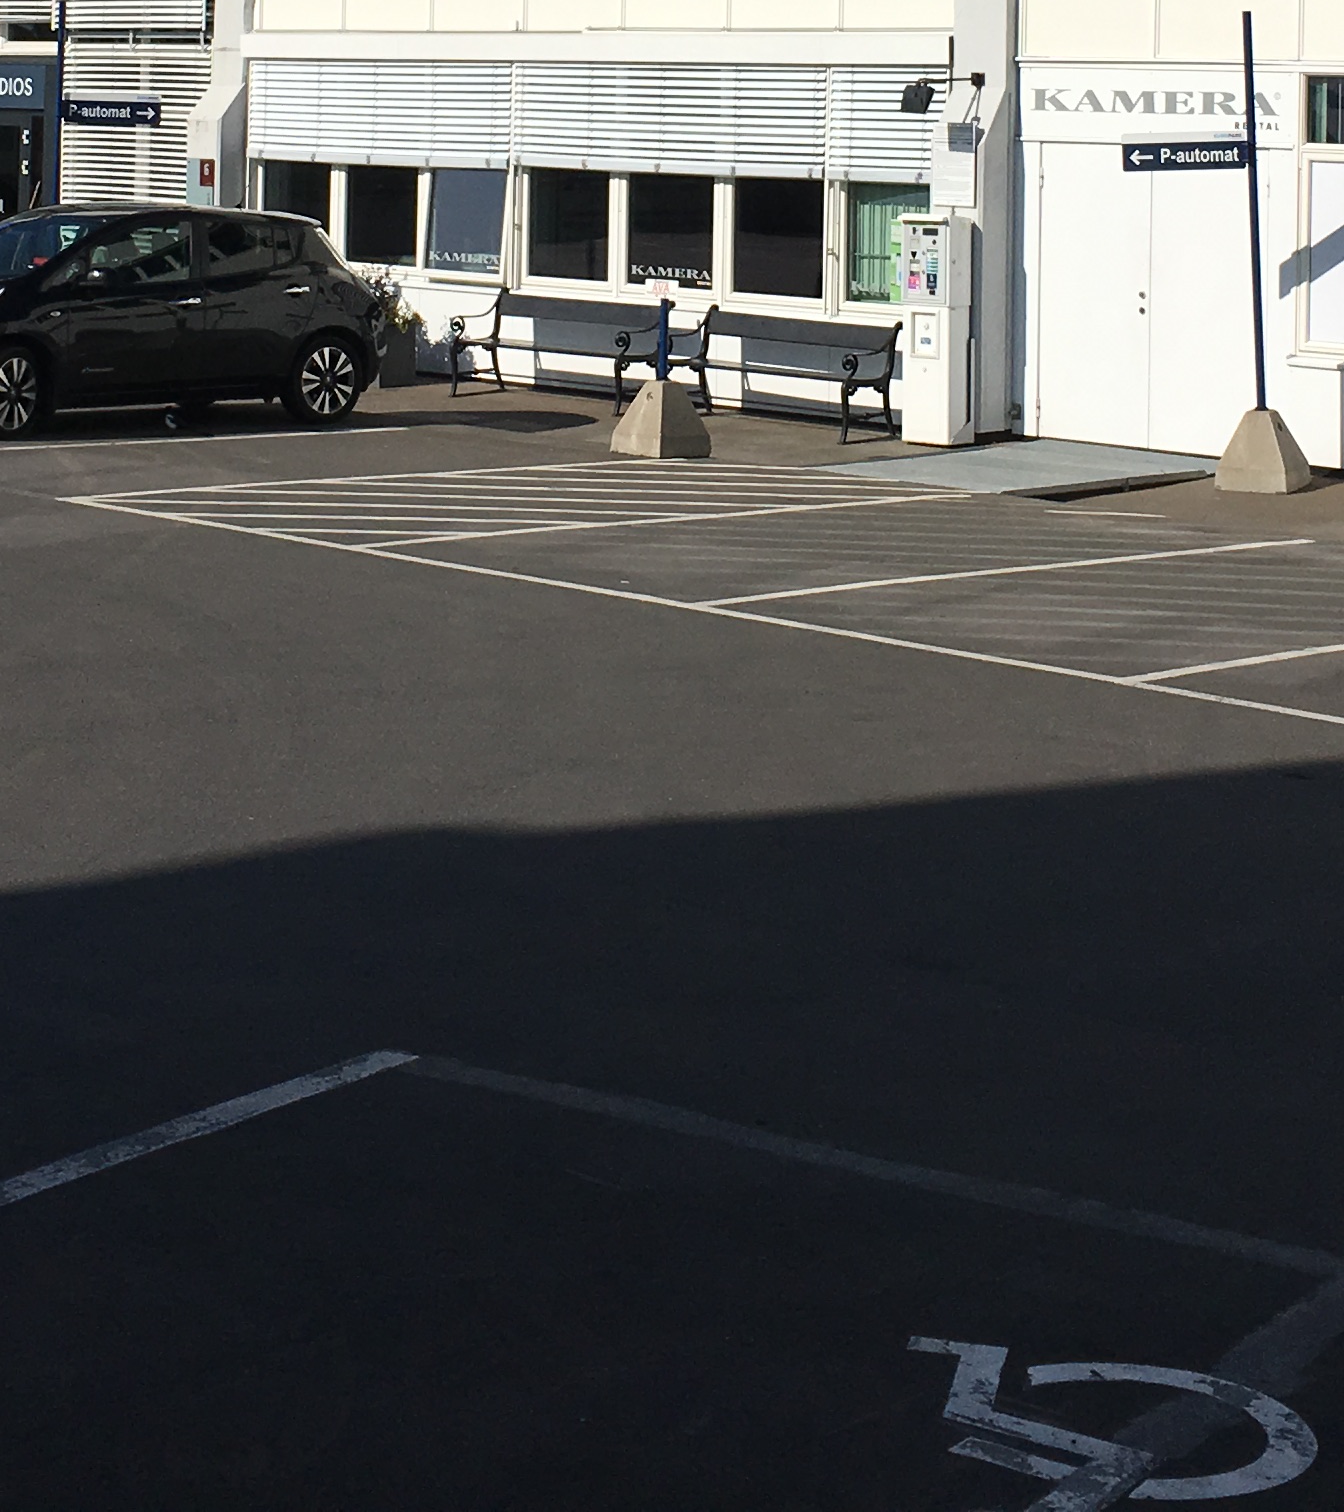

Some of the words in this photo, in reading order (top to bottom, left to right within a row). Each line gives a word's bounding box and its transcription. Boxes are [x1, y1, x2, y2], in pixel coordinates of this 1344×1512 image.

[1030, 88, 1280, 117] KAMERA
[69, 104, 131, 118] P-automat
[1234, 121, 1280, 131] RETAL
[1160, 146, 1239, 163] P-automat
[203, 163, 210, 176] 6
[429, 250, 501, 265] KAMERA
[631, 264, 711, 280] KAMERA
